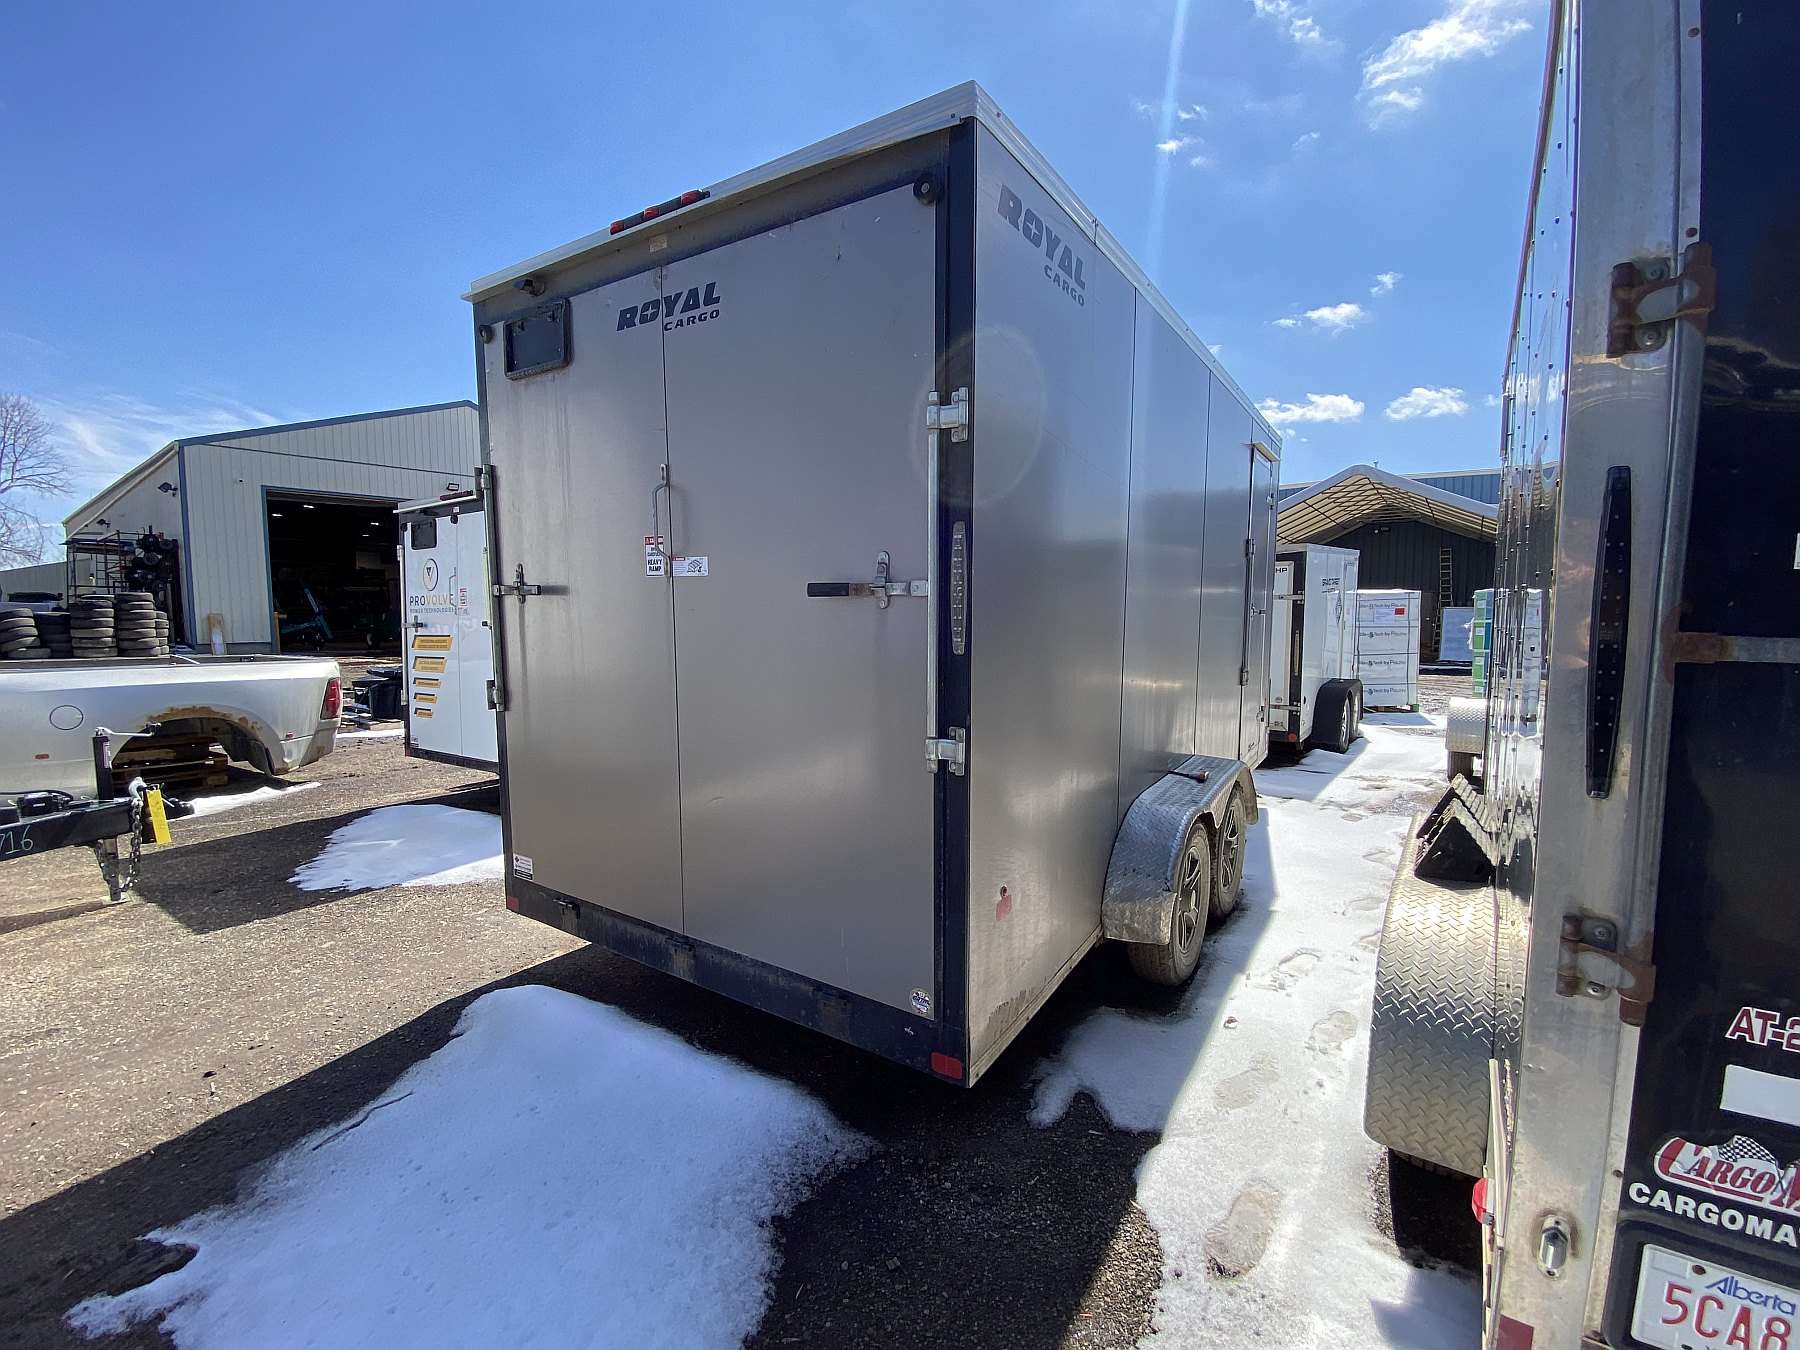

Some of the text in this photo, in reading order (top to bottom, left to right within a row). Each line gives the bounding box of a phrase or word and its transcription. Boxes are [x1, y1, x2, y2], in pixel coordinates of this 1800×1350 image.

[998, 184, 1085, 290] ROYAL
[616, 282, 721, 331] ROYAL
[1044, 264, 1085, 306] CARGO
[664, 309, 720, 331] CARGO
[1628, 1183, 1800, 1248] CARGOMA
[1705, 1275, 1797, 1316] Alberta
